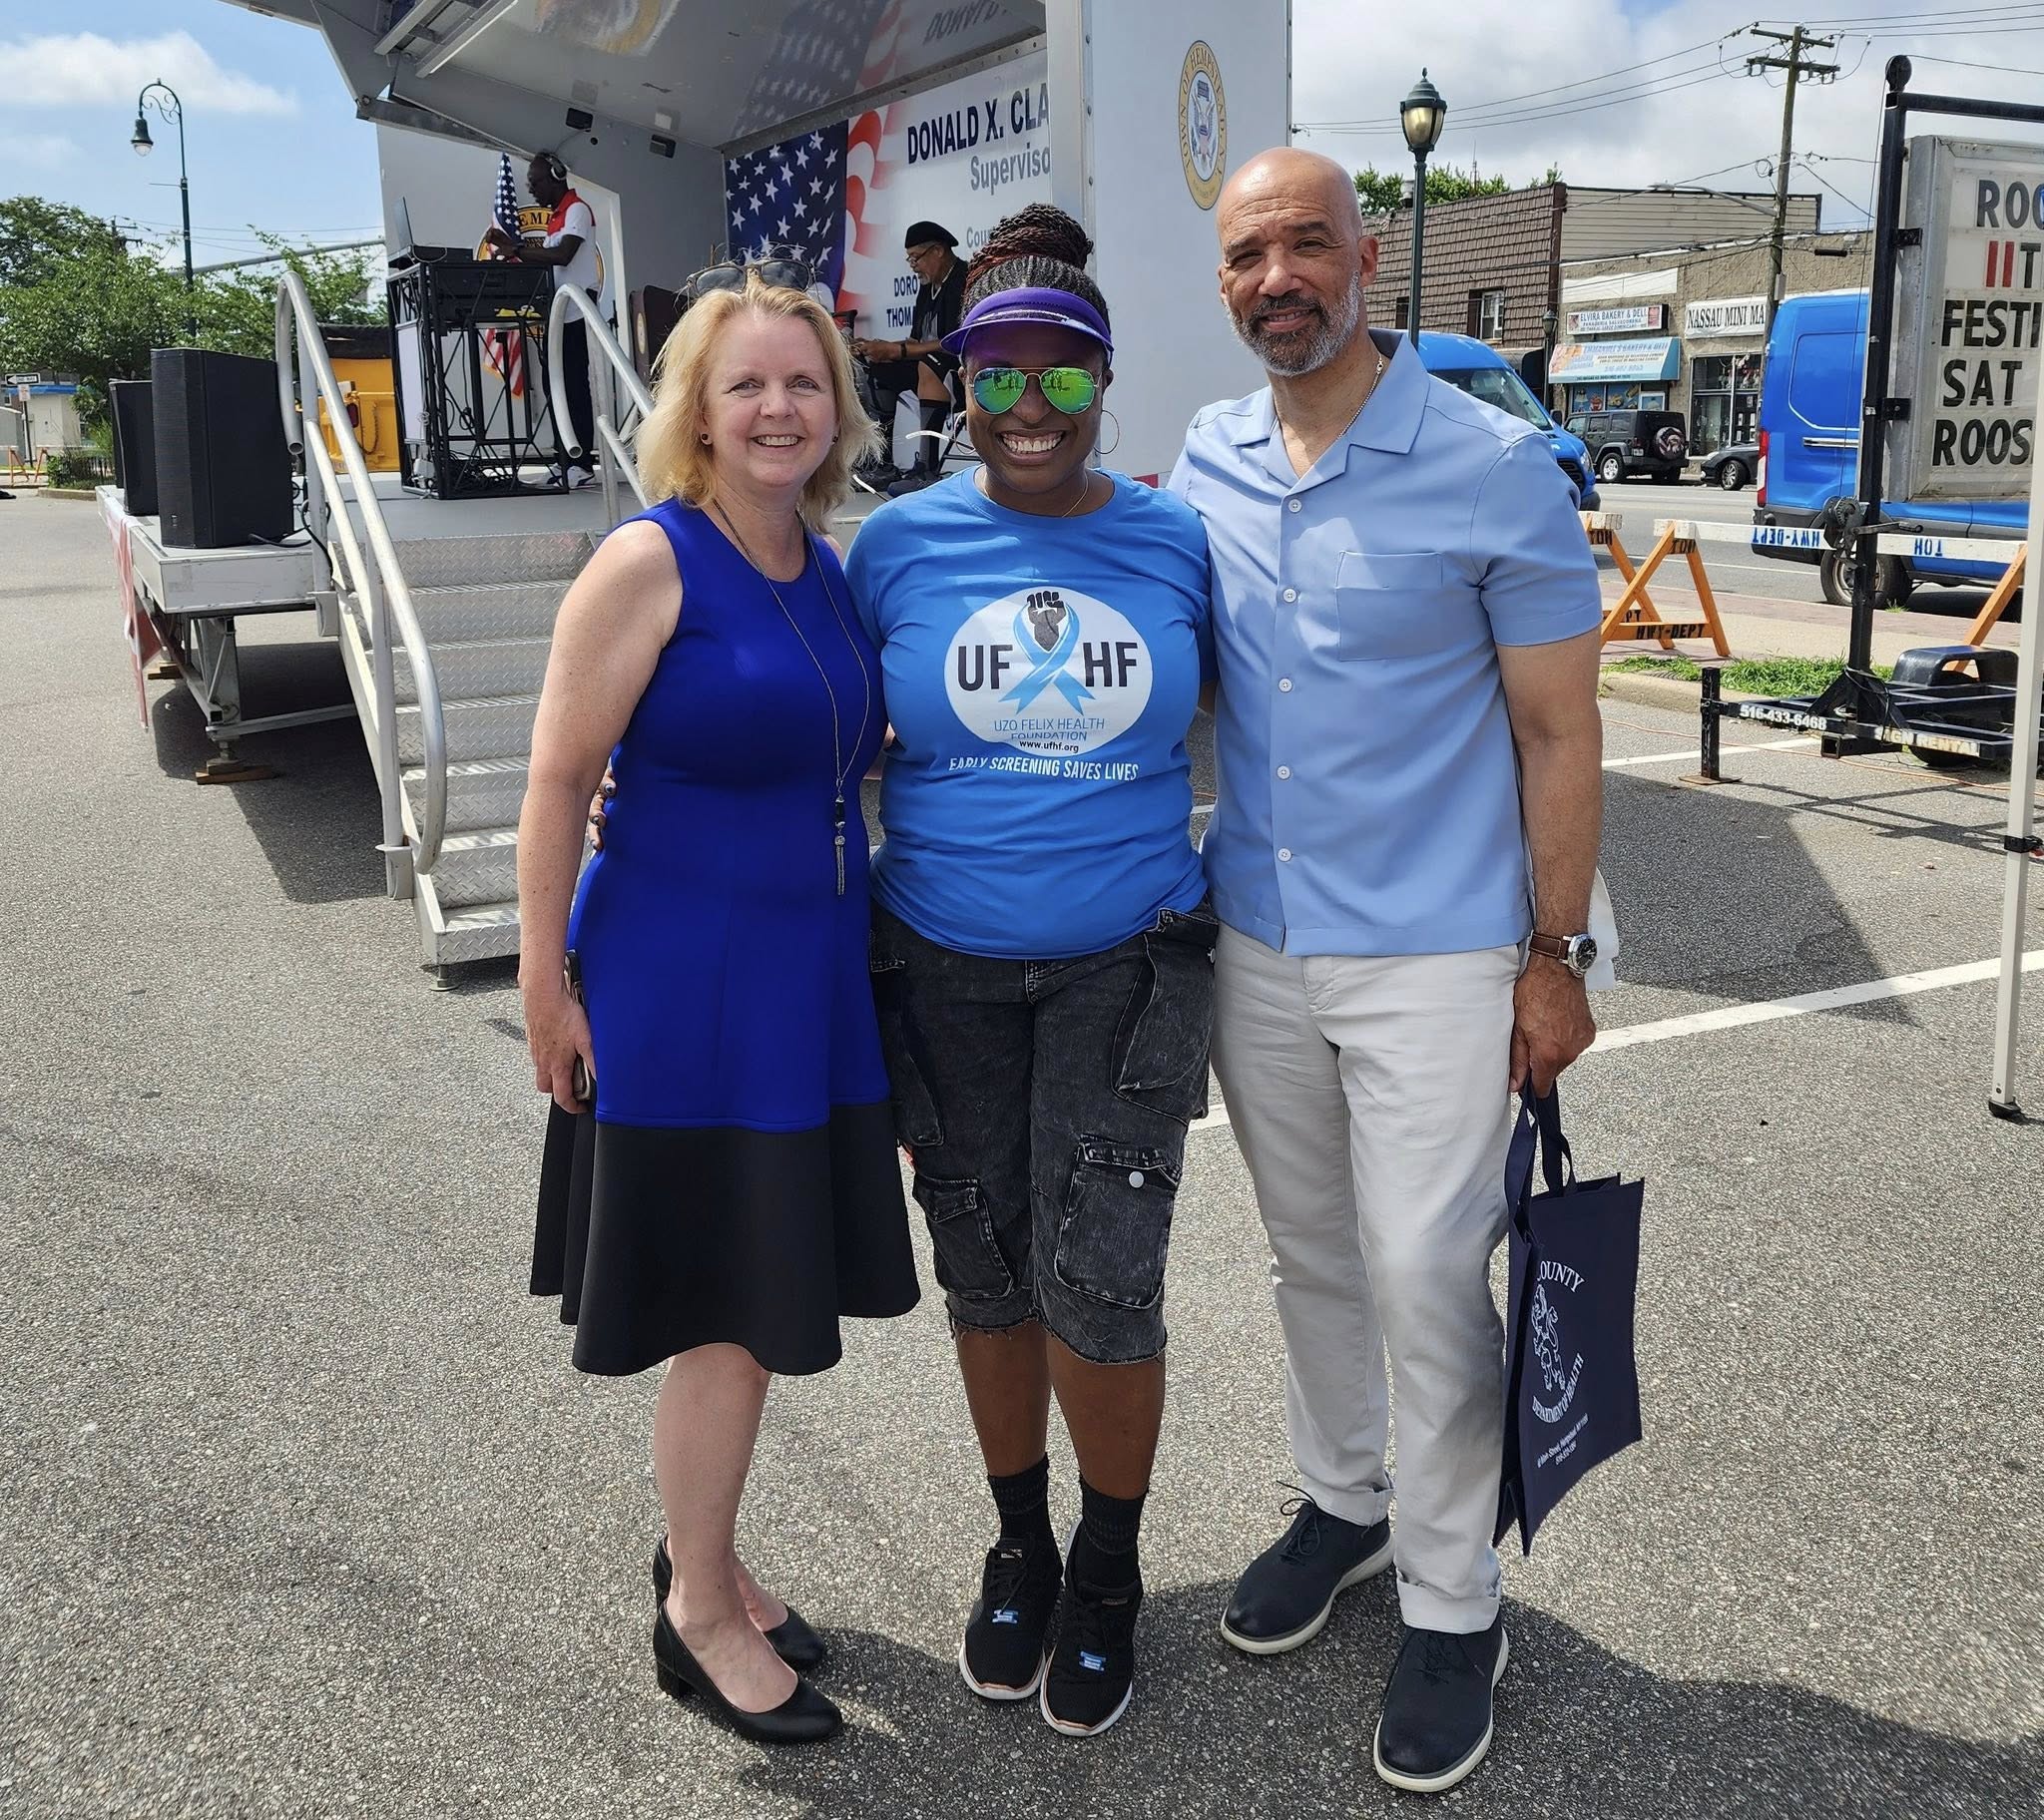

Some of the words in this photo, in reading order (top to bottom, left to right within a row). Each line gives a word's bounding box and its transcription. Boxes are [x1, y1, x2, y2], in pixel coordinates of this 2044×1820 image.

[907, 106, 979, 165] DONALD
[985, 98, 1004, 141] X.
[1010, 83, 1049, 134] CLA
[970, 143, 1051, 196] Superviso
[893, 274, 918, 297] DORO
[1580, 311, 1601, 322] ELVIRA
[1601, 309, 1625, 320] BAKERY
[1627, 309, 1631, 318] &
[1633, 307, 1647, 318] DELI
[1688, 307, 1723, 329] NASSAU
[1725, 305, 1748, 327] MINI
[1750, 304, 1765, 325] MA
[1941, 299, 2043, 348] FESTI
[1942, 359, 2023, 408] SAT
[1932, 418, 2033, 467] ROOS
[1752, 525, 1820, 548] HWY-DEPT
[1914, 538, 1943, 558] TOH
[1635, 624, 1706, 640] HWY-DEPT
[994, 719, 1018, 732] UZO
[1021, 718, 1054, 731] FELIX
[1057, 717, 1105, 729] HEALTH
[1739, 704, 1827, 730] 516-433-6468
[1011, 730, 1088, 741] FOUNDATION
[1019, 739, 1079, 753] www.ufhf.org
[949, 756, 988, 772] EARLY
[989, 756, 1059, 776] SCREENING
[1063, 761, 1101, 780] SAVES
[1105, 762, 1139, 781] LIVES
[1536, 1260, 1586, 1293] OUNTY
